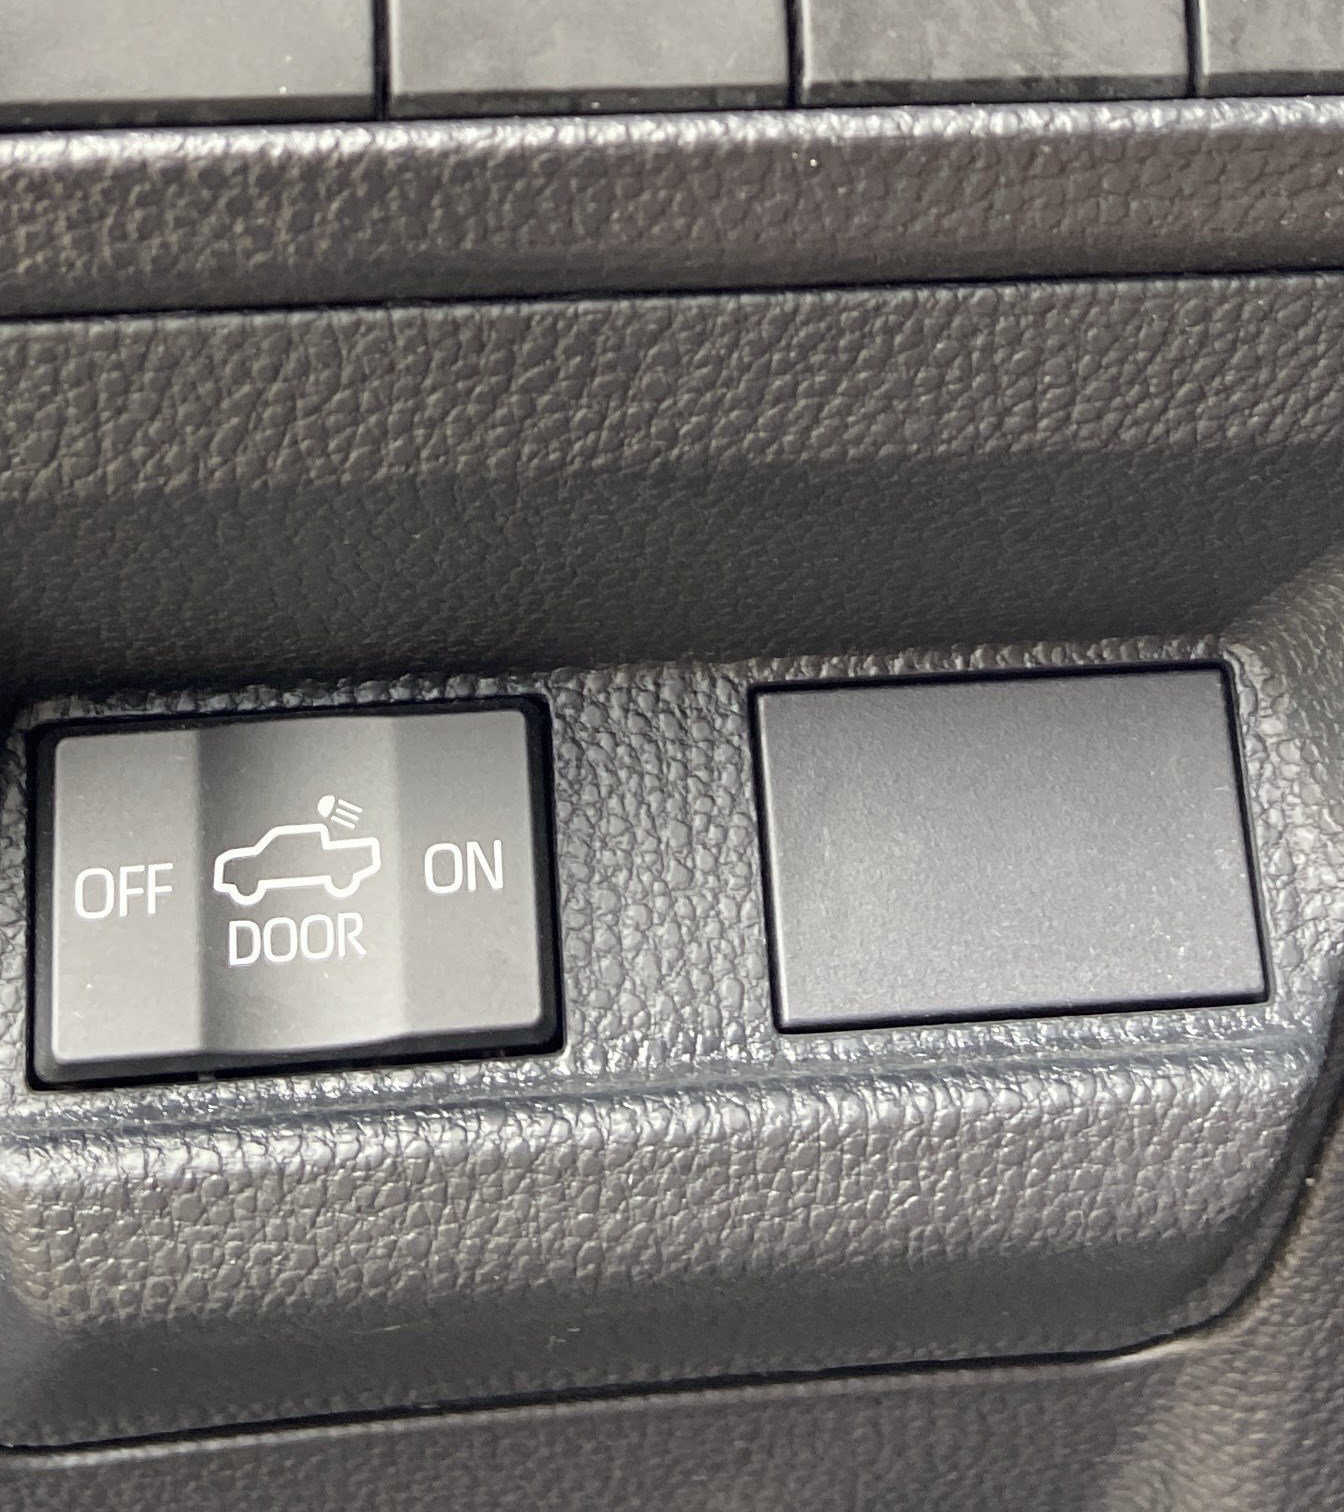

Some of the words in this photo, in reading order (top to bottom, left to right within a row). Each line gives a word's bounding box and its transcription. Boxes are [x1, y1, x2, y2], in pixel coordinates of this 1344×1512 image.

[73, 861, 174, 920] OFF
[423, 838, 504, 895] ON
[226, 911, 367, 967] DOOR
